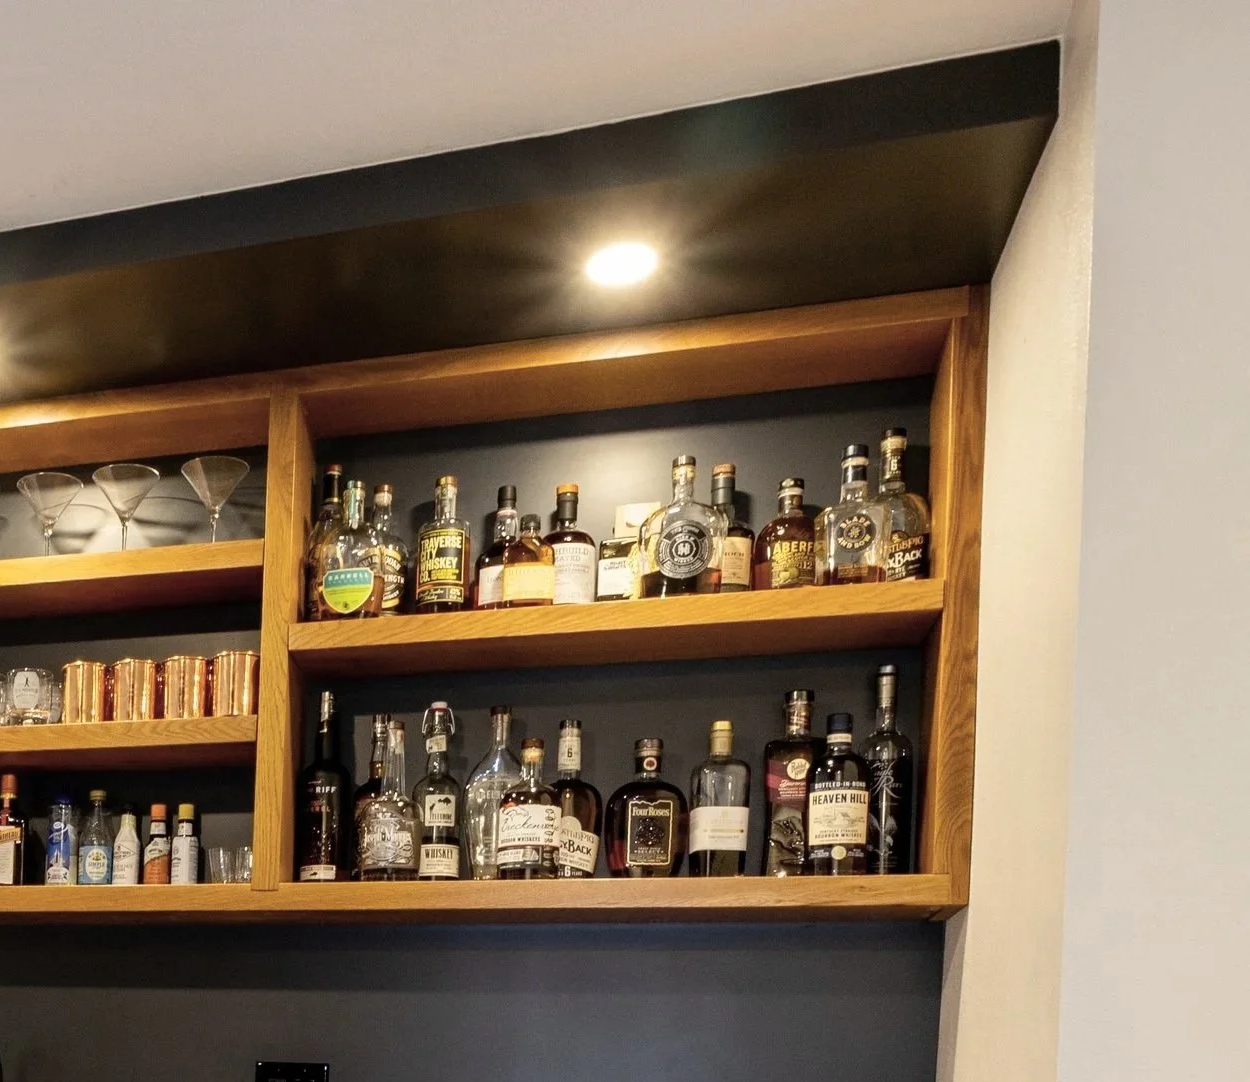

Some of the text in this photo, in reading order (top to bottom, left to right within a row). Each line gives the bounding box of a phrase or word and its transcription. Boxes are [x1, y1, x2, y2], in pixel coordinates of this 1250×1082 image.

[840, 515, 871, 529] BLADE
[421, 535, 462, 551] TRAVERSE
[773, 540, 814, 555] ABERF
[837, 534, 871, 549] AND BOW
[421, 548, 438, 562] CITY
[420, 557, 458, 571] WHISKEY
[419, 571, 431, 583] CO.
[315, 786, 338, 794] RIFF
[812, 792, 867, 806] HEAVEN HILL
[632, 807, 670, 817] Four Roses
[424, 848, 453, 860] WHISKEY
[564, 866, 571, 877] 6
